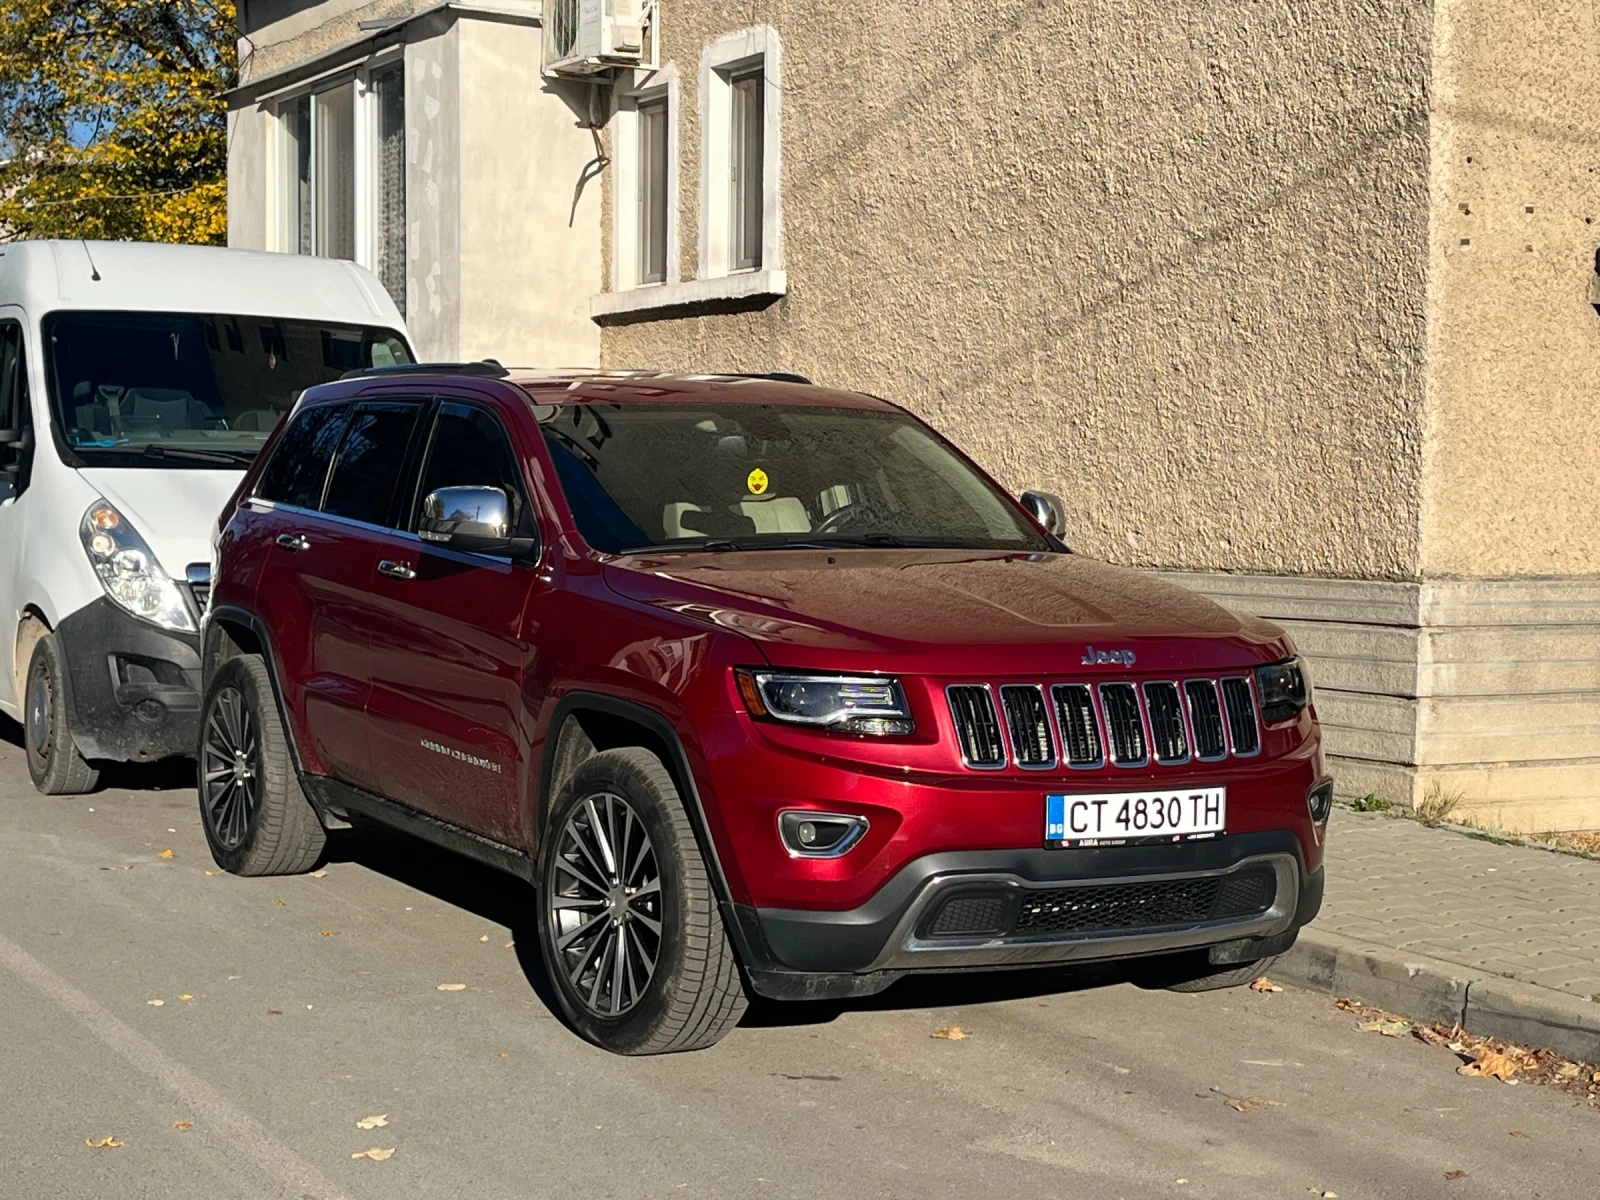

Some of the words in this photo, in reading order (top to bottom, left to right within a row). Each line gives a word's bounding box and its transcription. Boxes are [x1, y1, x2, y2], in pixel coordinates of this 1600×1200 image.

[1081, 645, 1136, 668] Jeep
[1070, 800, 1108, 833] CT
[1115, 796, 1182, 831] 4830
[1188, 793, 1220, 827] TH
[1049, 824, 1063, 834] BG
[1078, 838, 1099, 847] AURA
